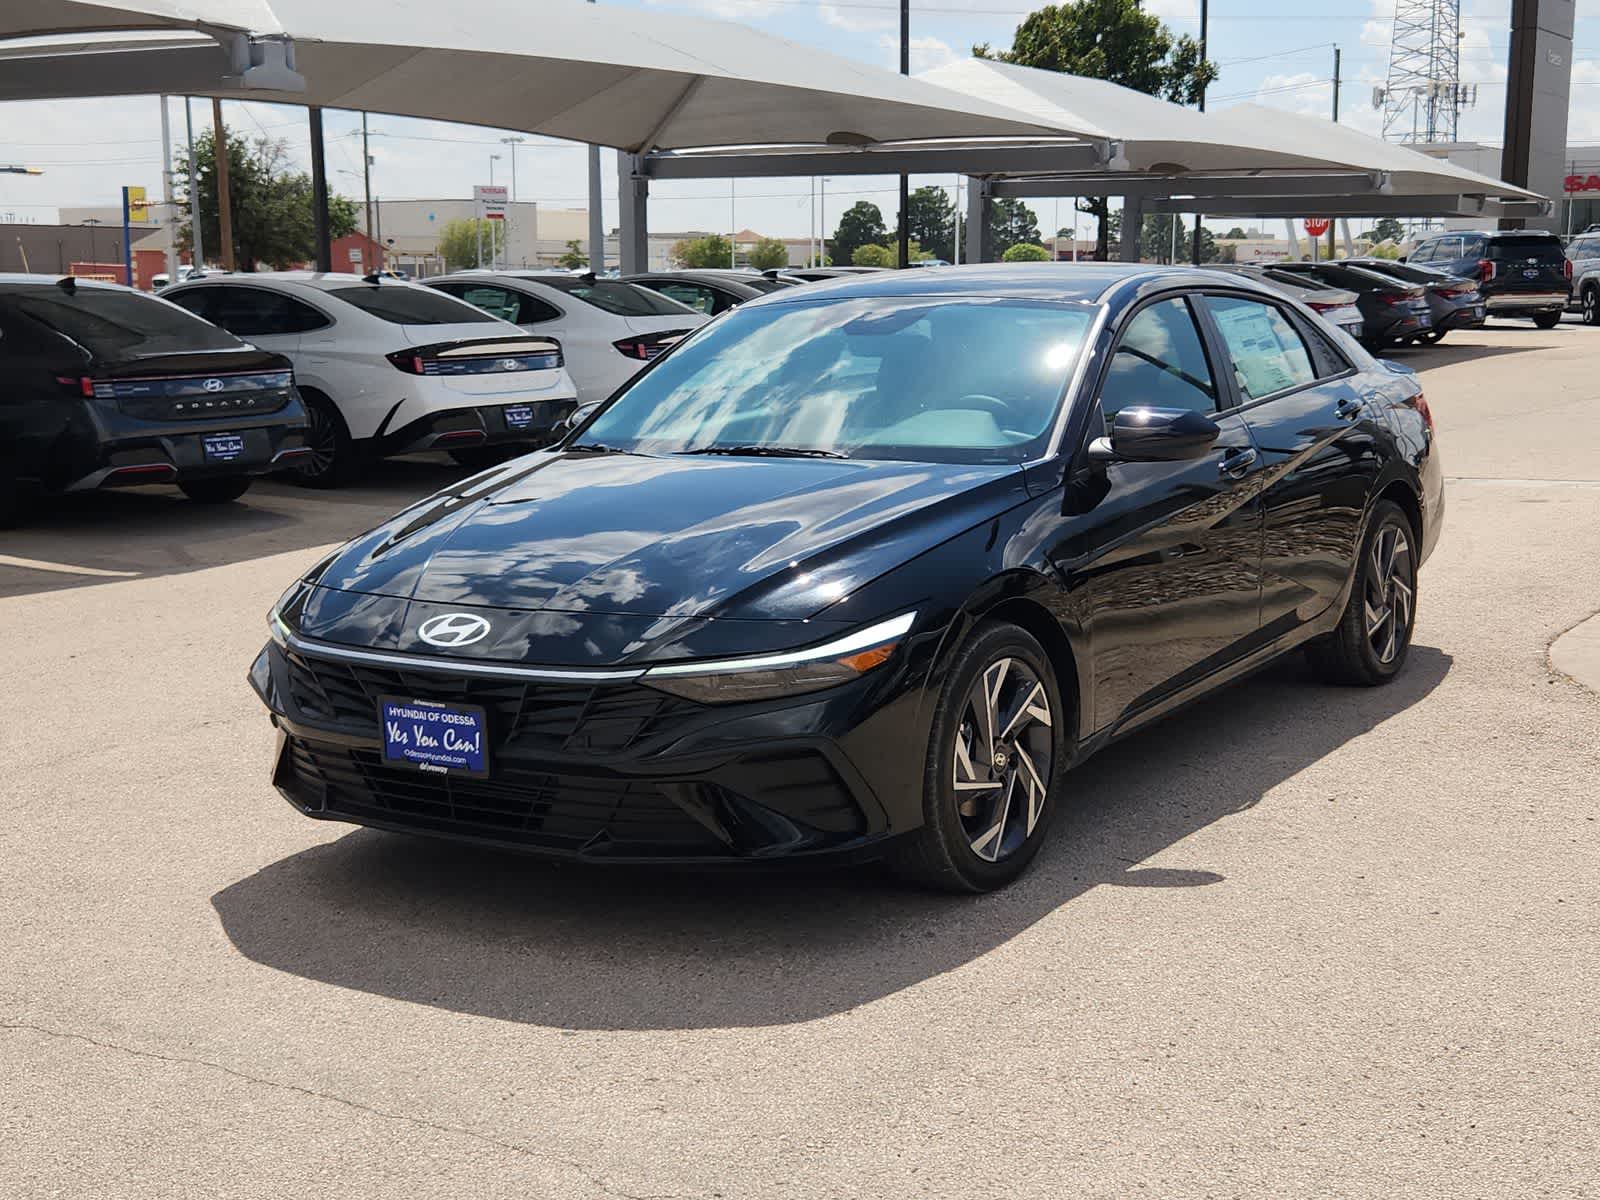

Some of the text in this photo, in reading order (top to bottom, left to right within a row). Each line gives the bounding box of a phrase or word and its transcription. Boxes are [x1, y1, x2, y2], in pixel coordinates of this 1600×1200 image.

[1304, 217, 1328, 228] STOP
[389, 706, 476, 726] HYUNDAI OF ODESSA
[386, 721, 480, 755] Yes You Can!
